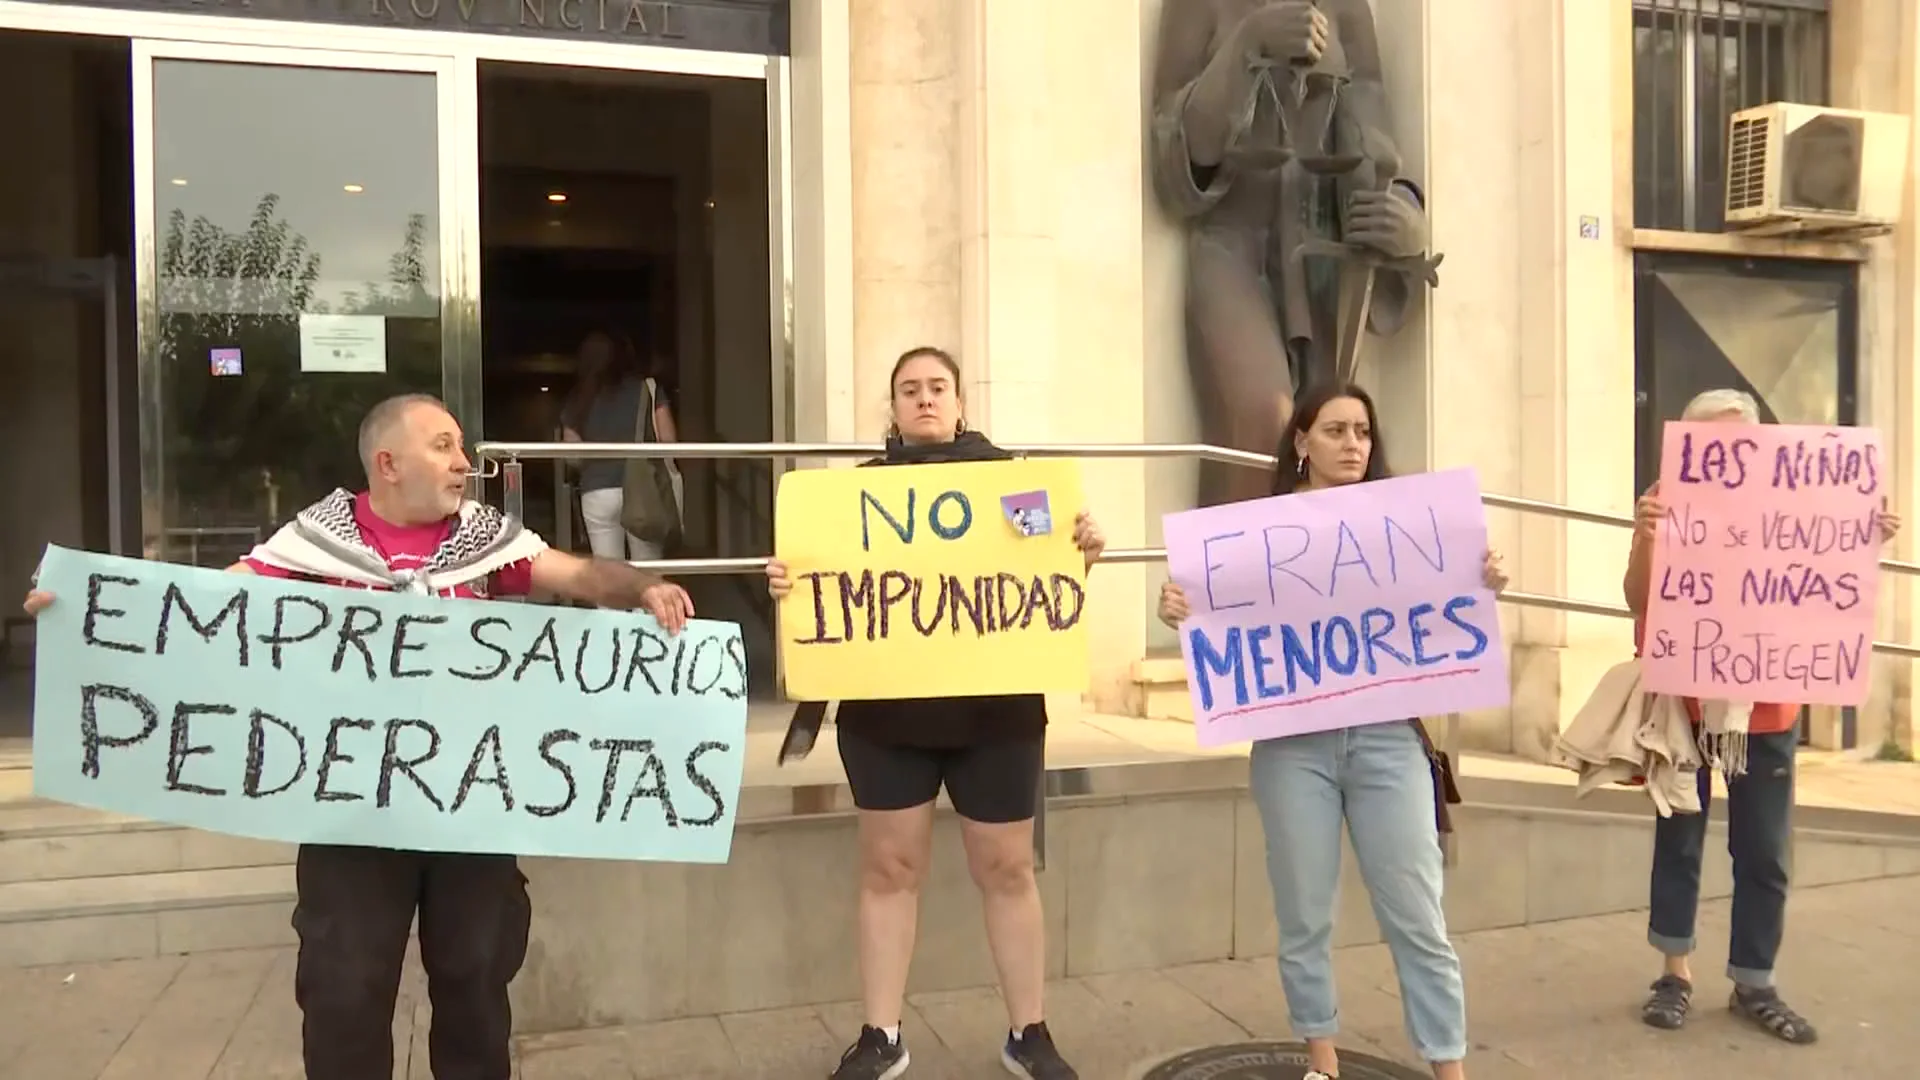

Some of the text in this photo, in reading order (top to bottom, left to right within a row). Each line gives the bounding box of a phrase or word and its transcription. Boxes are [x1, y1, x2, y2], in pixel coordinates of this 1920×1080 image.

[1678, 432, 1878, 495] LAS NIÑAS
[861, 487, 973, 552] NO
[1762, 507, 1877, 556] VENDEN
[1203, 505, 1445, 611] ERAN
[1660, 563, 1861, 611] LAS NIÑAS
[82, 572, 747, 700] EMPRESAURIOS
[793, 568, 1085, 645] IMPUNIDAD
[1188, 596, 1489, 712] MENORES
[1692, 618, 1865, 690] PROTEGEN
[80, 682, 730, 829] PEDERASTAS
